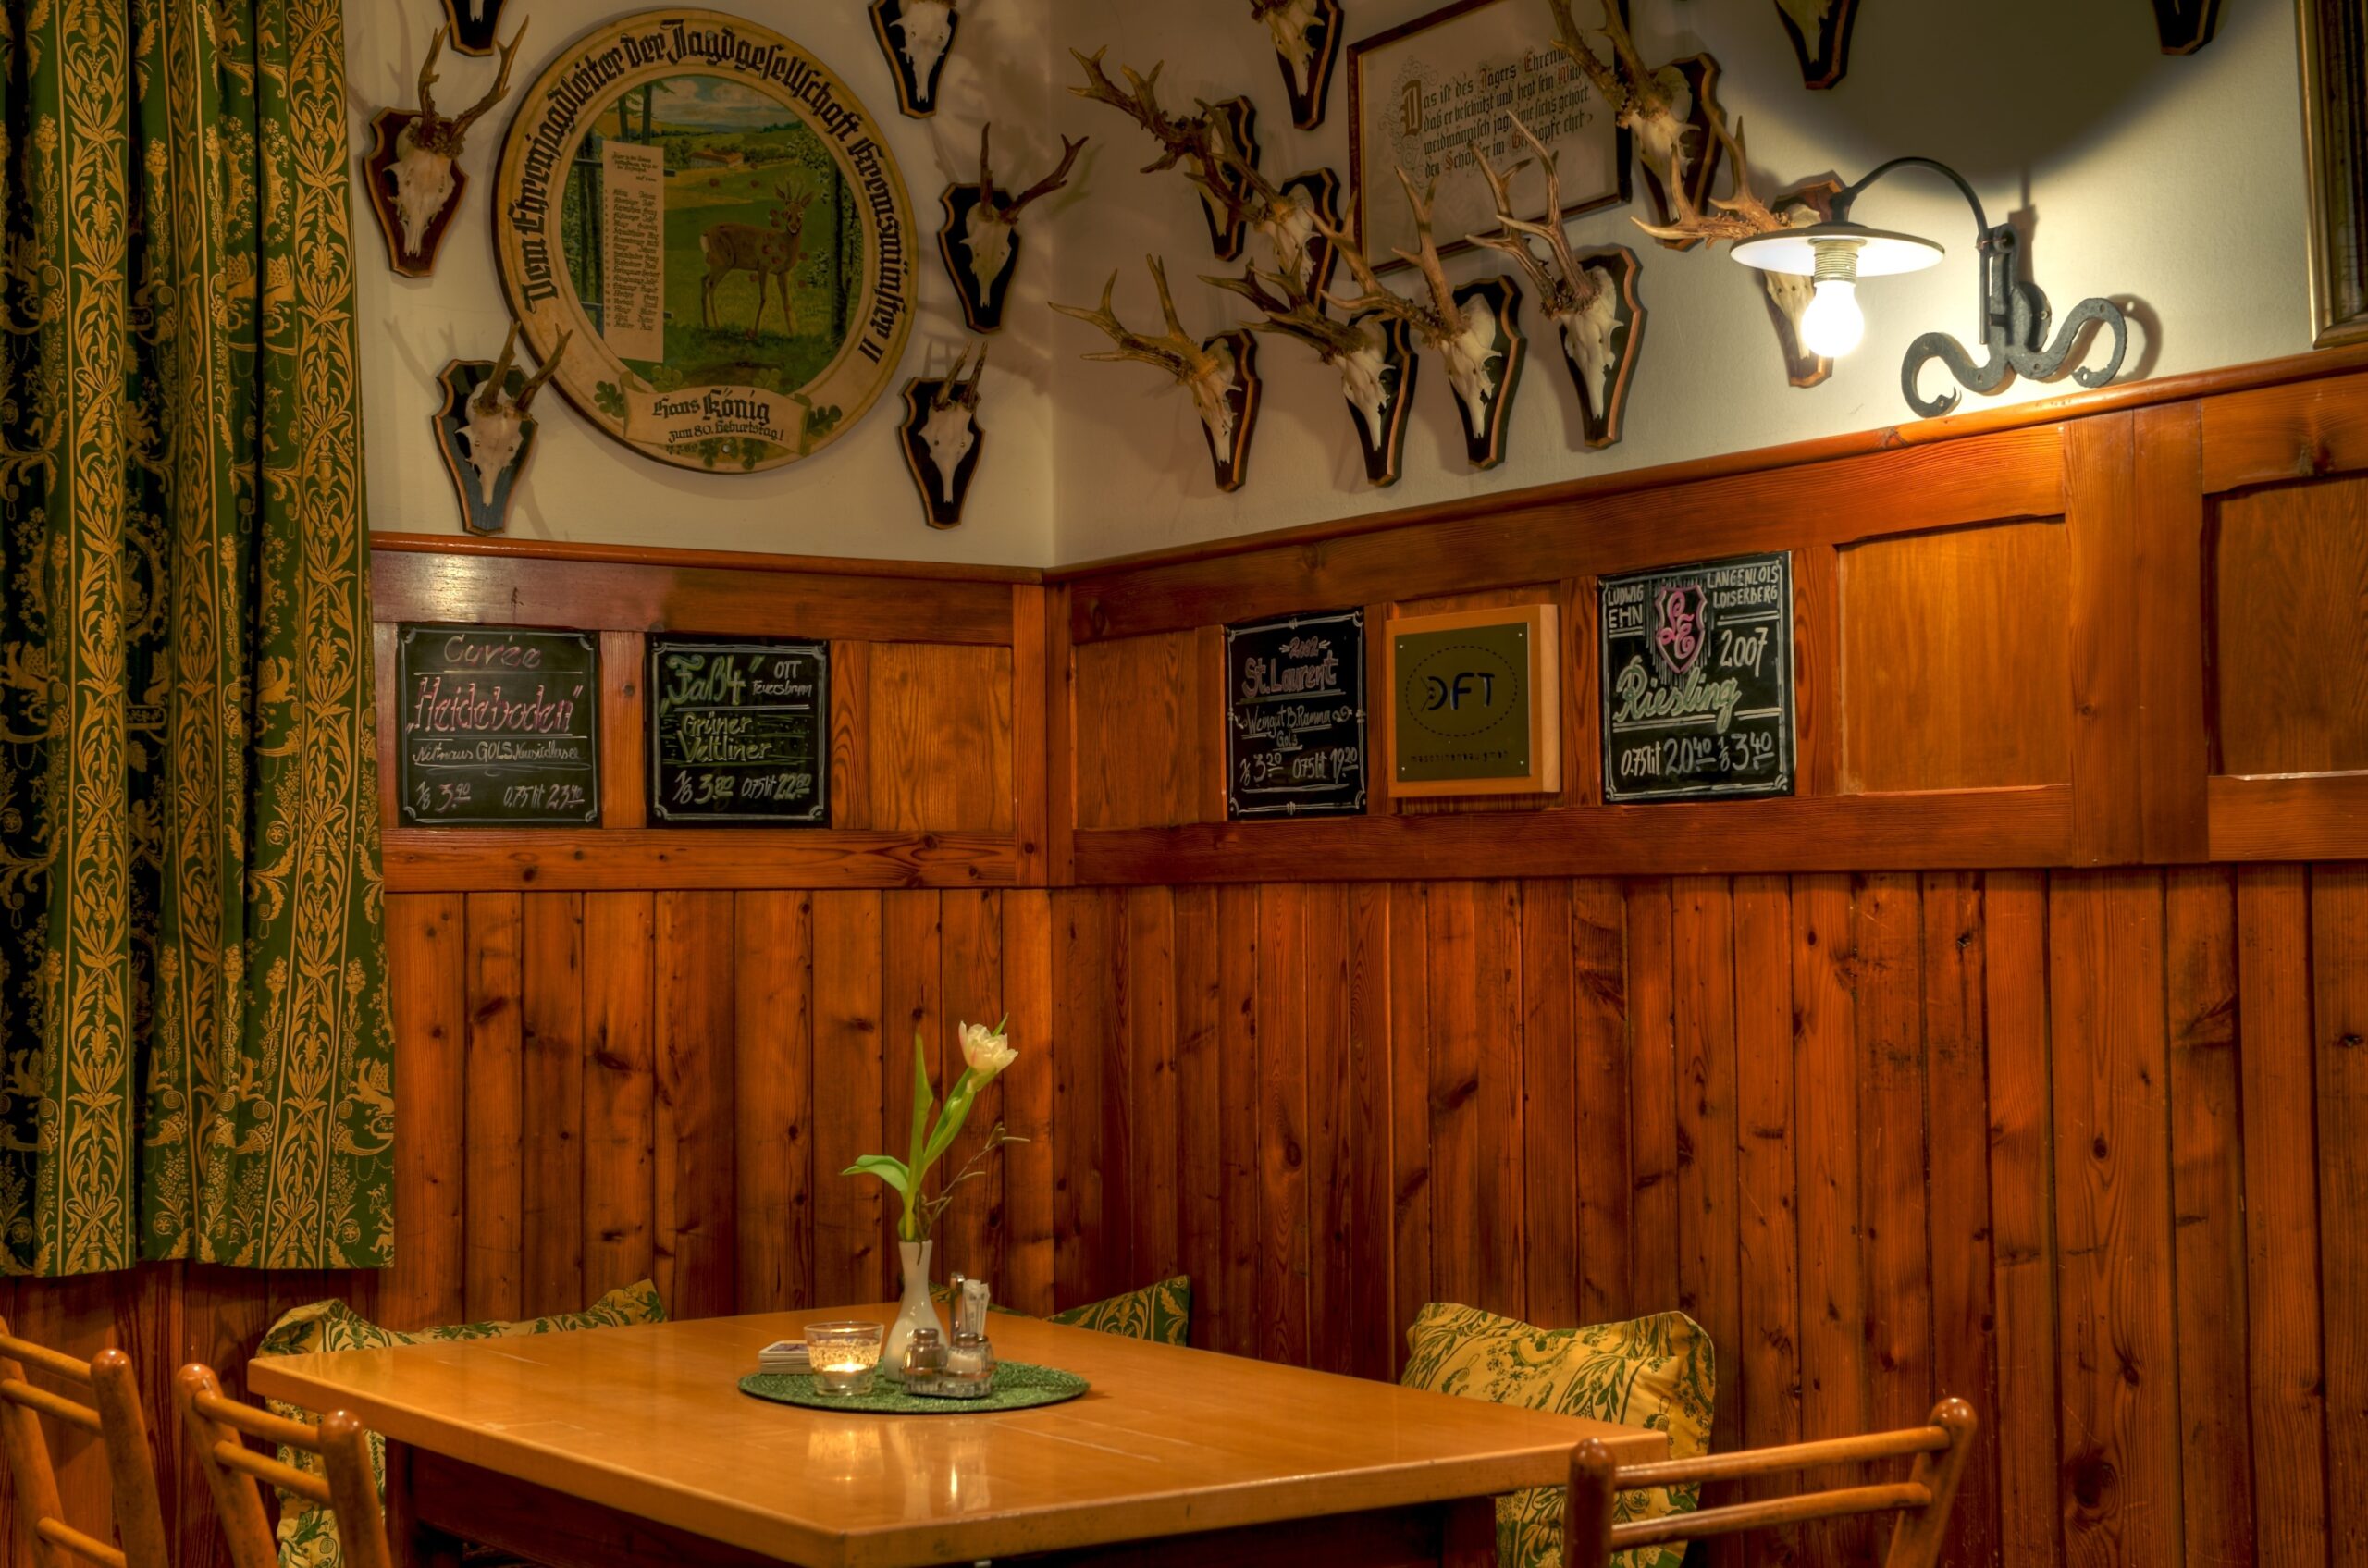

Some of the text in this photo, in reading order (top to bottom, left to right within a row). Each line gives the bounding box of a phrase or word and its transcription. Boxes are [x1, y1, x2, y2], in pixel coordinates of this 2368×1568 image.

[620, 32, 667, 68] der
[1456, 80, 1474, 98] des
[1497, 84, 1514, 107] und
[652, 387, 771, 426] Hans König
[668, 428, 693, 444] zum
[694, 424, 714, 438] 80.
[1707, 565, 1779, 589] LANGENLOIS
[1608, 584, 1645, 607] LUDWIG
[1713, 585, 1778, 609] LOISERBERG
[1609, 604, 1644, 629] EHN
[444, 634, 541, 669] Cuvée
[1720, 627, 1769, 677] 2007
[773, 660, 803, 680] OTT
[1612, 655, 1743, 734] Riesling
[682, 710, 753, 737] Grüner
[676, 729, 772, 763] Veltliner
